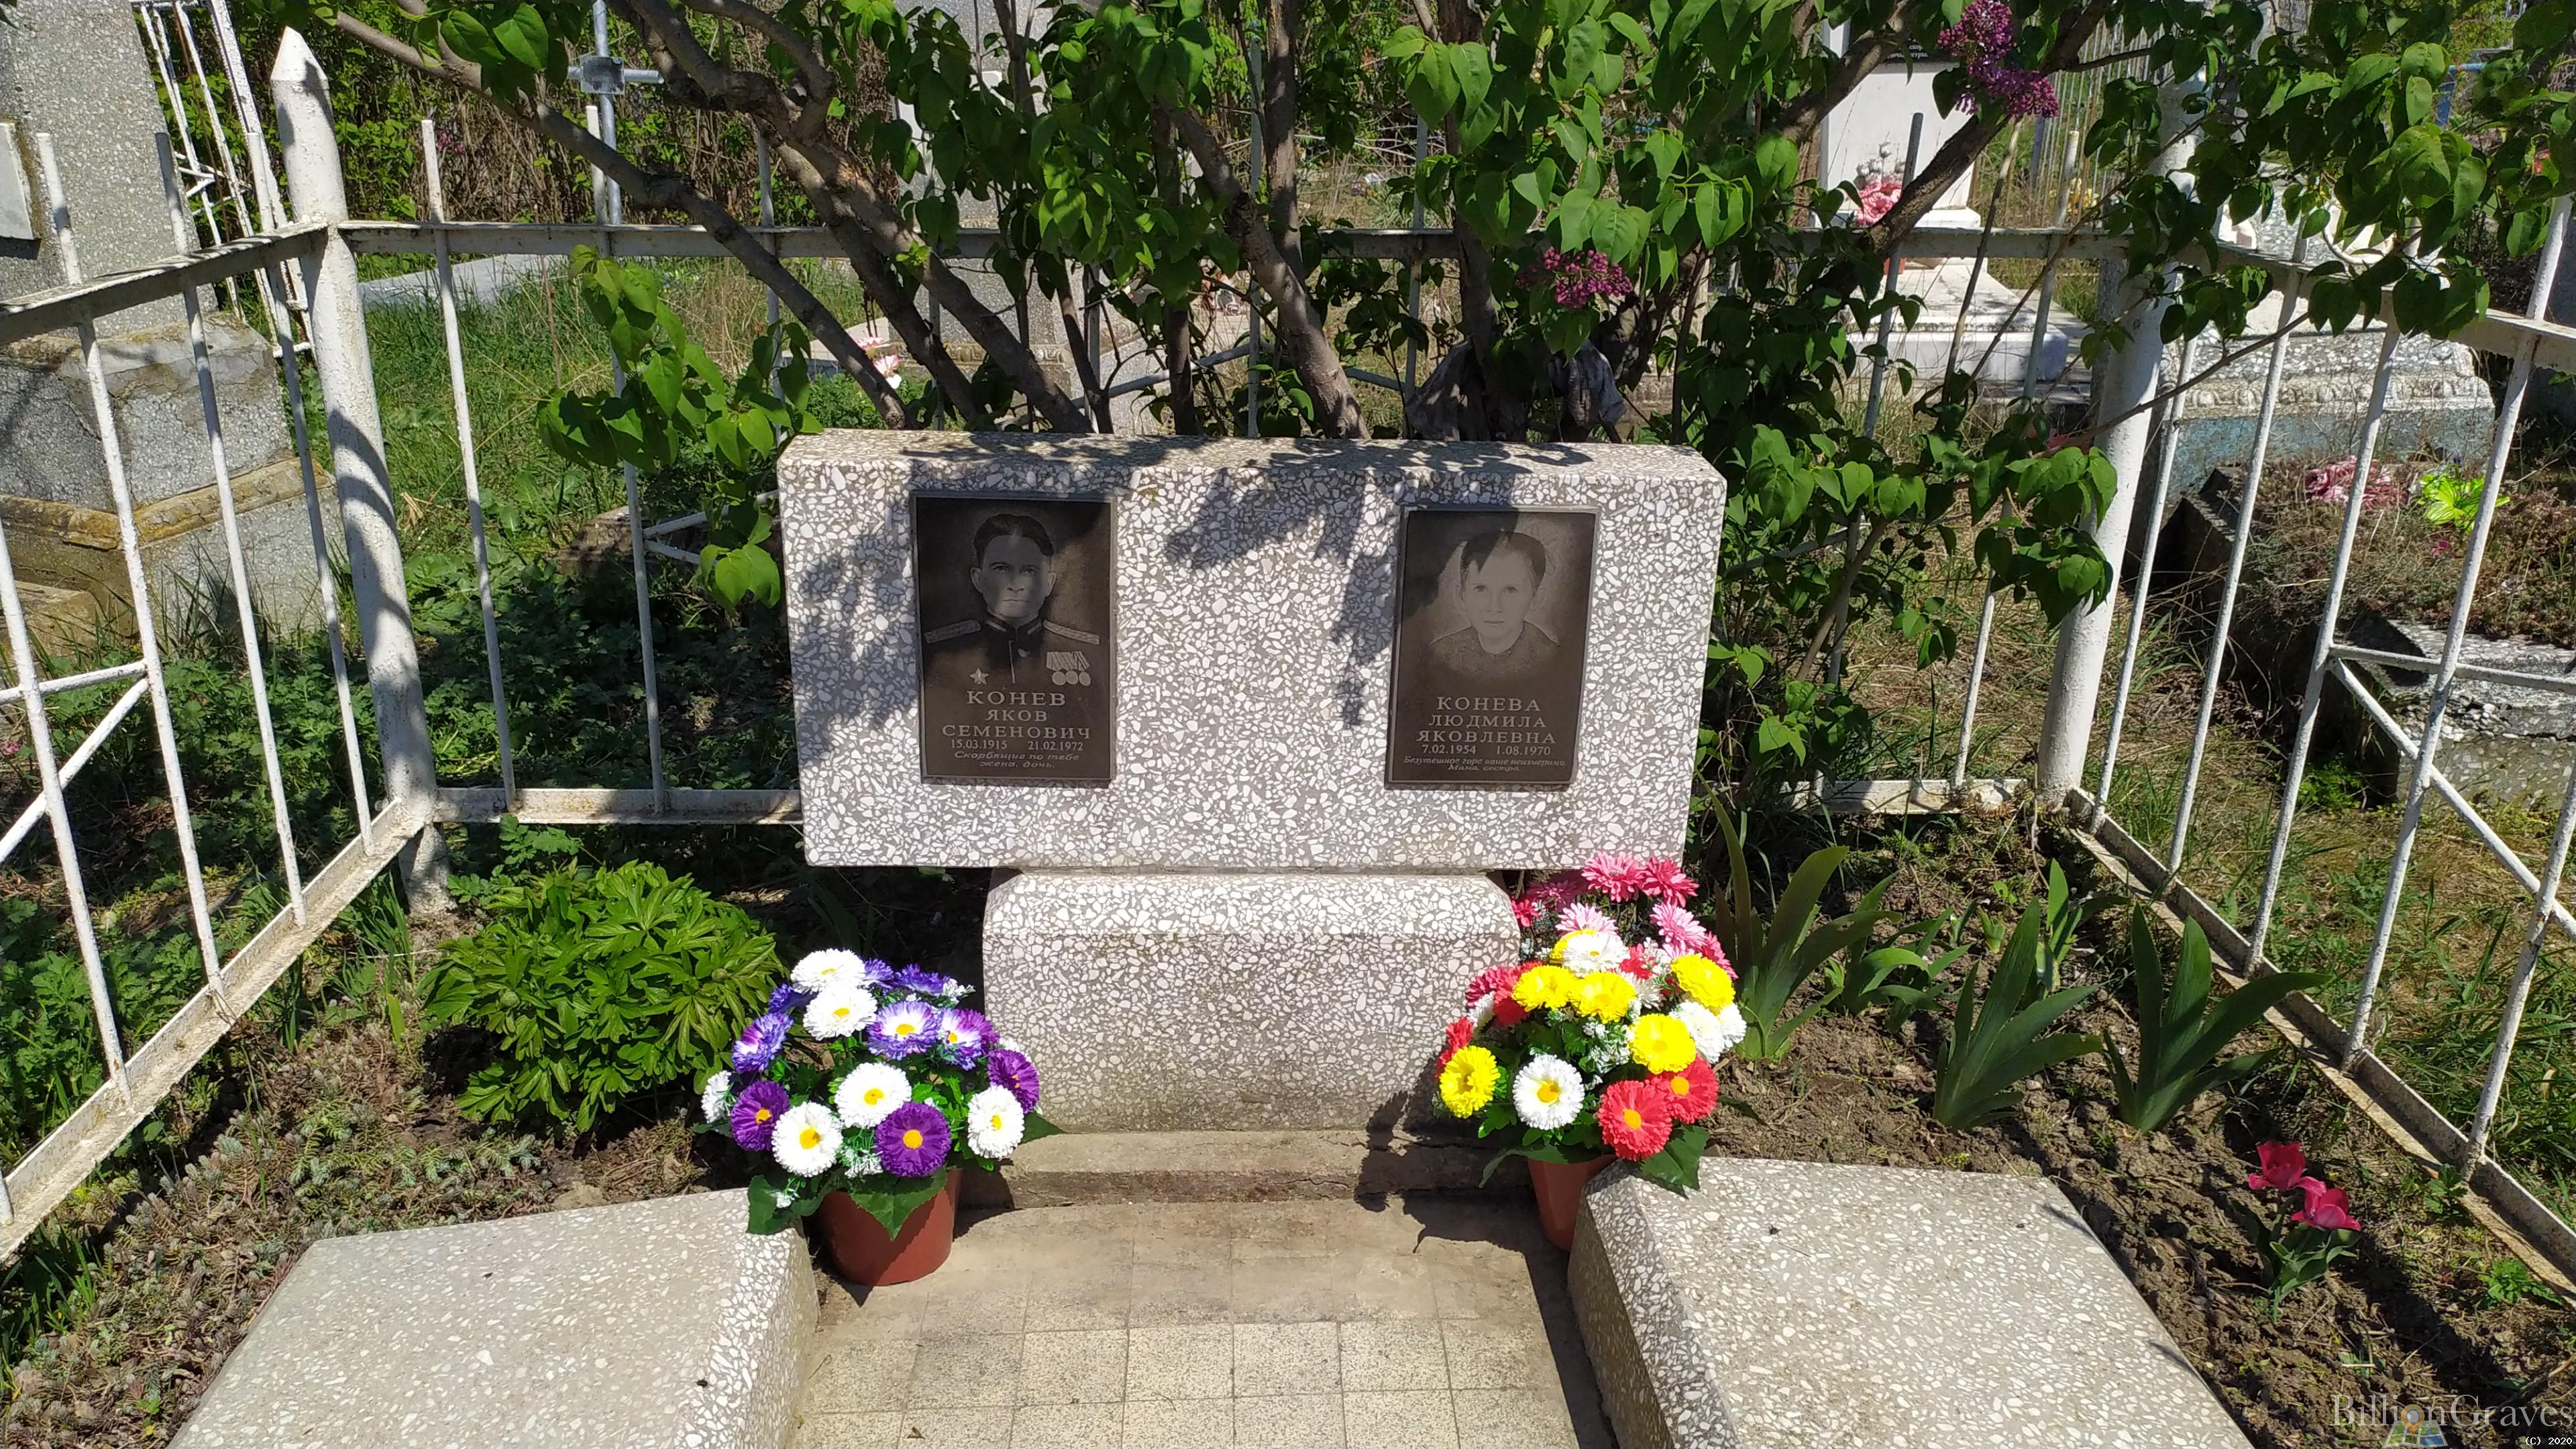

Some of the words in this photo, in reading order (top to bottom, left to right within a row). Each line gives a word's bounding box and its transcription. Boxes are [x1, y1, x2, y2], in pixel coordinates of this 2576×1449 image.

[967, 690, 1066, 706] КОНЕВ
[1436, 696, 1541, 712] КОНЕВА
[985, 710, 1048, 722] ЯКОВ
[1428, 714, 1546, 729] ЛЮДМИЛА
[942, 725, 1091, 739] СЕМЕНОВИЧ
[1415, 731, 1556, 744] ЯКОВЛЕВНА
[951, 739, 1008, 750] 15.03.1915
[1028, 741, 1084, 751] 21.02.1972
[1421, 744, 1477, 755] 7.02.1954
[1496, 745, 1551, 756] 1.08.1970
[954, 750, 1026, 760] Скорбящие
[1028, 753, 1044, 761] по
[1047, 752, 1080, 761] тебе
[1403, 755, 1460, 765] Безутешное
